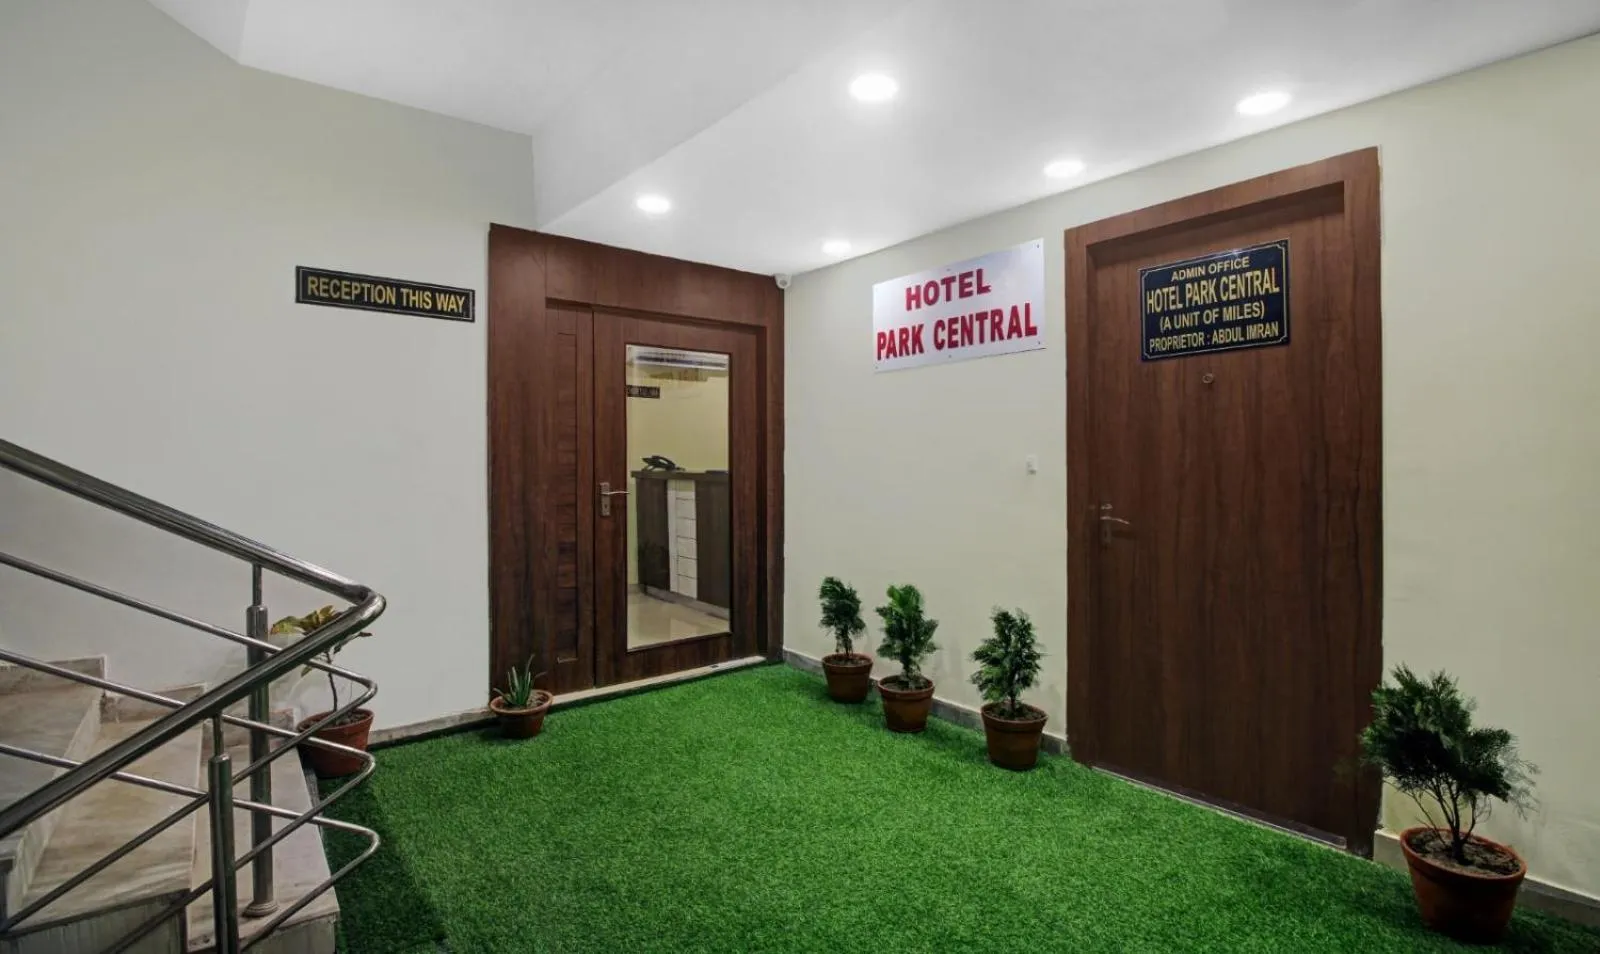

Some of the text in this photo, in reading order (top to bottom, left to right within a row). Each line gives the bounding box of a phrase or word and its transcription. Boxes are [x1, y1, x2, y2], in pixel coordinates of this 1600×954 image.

[1171, 256, 1250, 282] ADMIN OFFICE
[307, 276, 466, 313] RECEPTION THIS WAY
[905, 268, 992, 311] HOTEL
[1146, 267, 1280, 314] HOTEL PARK CENTRAL
[876, 302, 1038, 361] PARK CENTRAL
[1159, 300, 1265, 332] (A UNIT OF MILES)
[1150, 332, 1205, 352] PROPRIETOR
[1211, 327, 1244, 344] ABDUL
[1246, 321, 1279, 340] IMRAN
